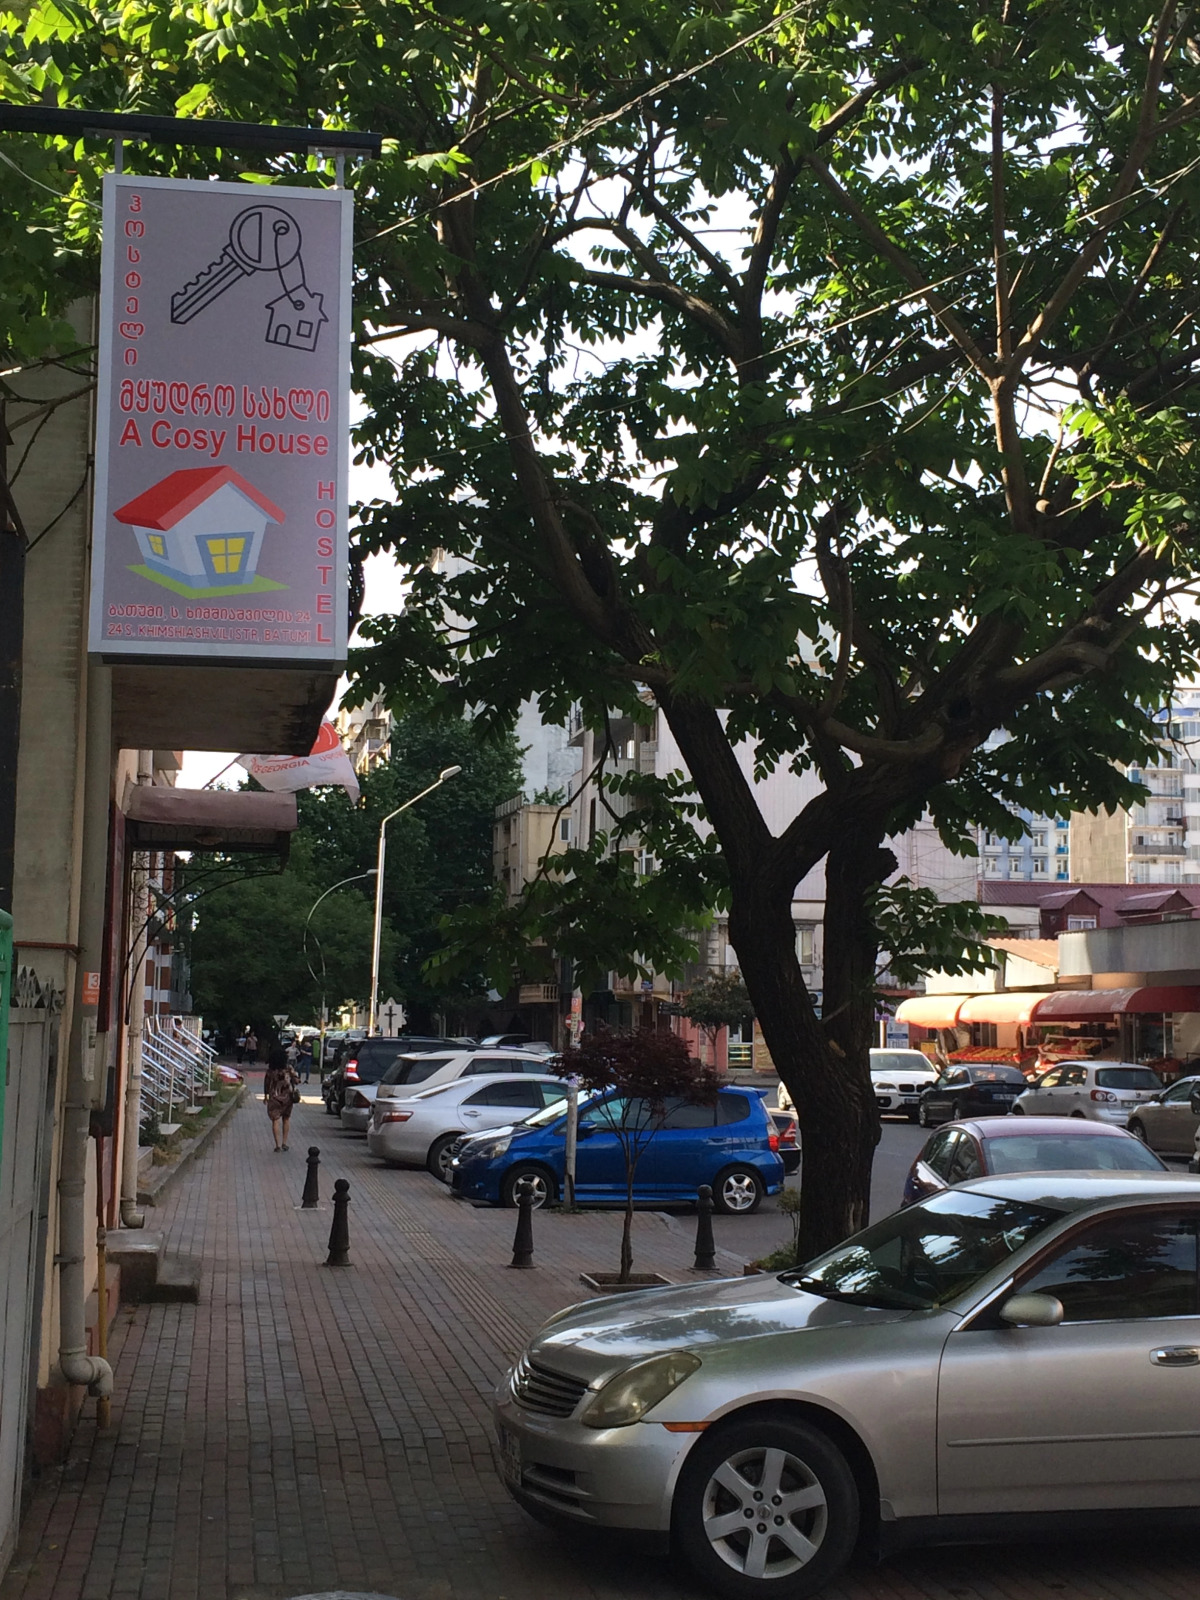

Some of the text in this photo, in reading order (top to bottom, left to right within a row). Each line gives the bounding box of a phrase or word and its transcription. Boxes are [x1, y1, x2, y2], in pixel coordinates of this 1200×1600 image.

[120, 379, 330, 423] მყუდრო სახლი
[119, 418, 330, 459] A Cosy House
[314, 480, 336, 644] HOSTEL
[295, 610, 311, 623] 24
[107, 622, 123, 636] 24
[138, 624, 232, 640] KHIMSHIASHVILI
[263, 628, 311, 643] BATUMI
[261, 760, 310, 773] GEORGIA
